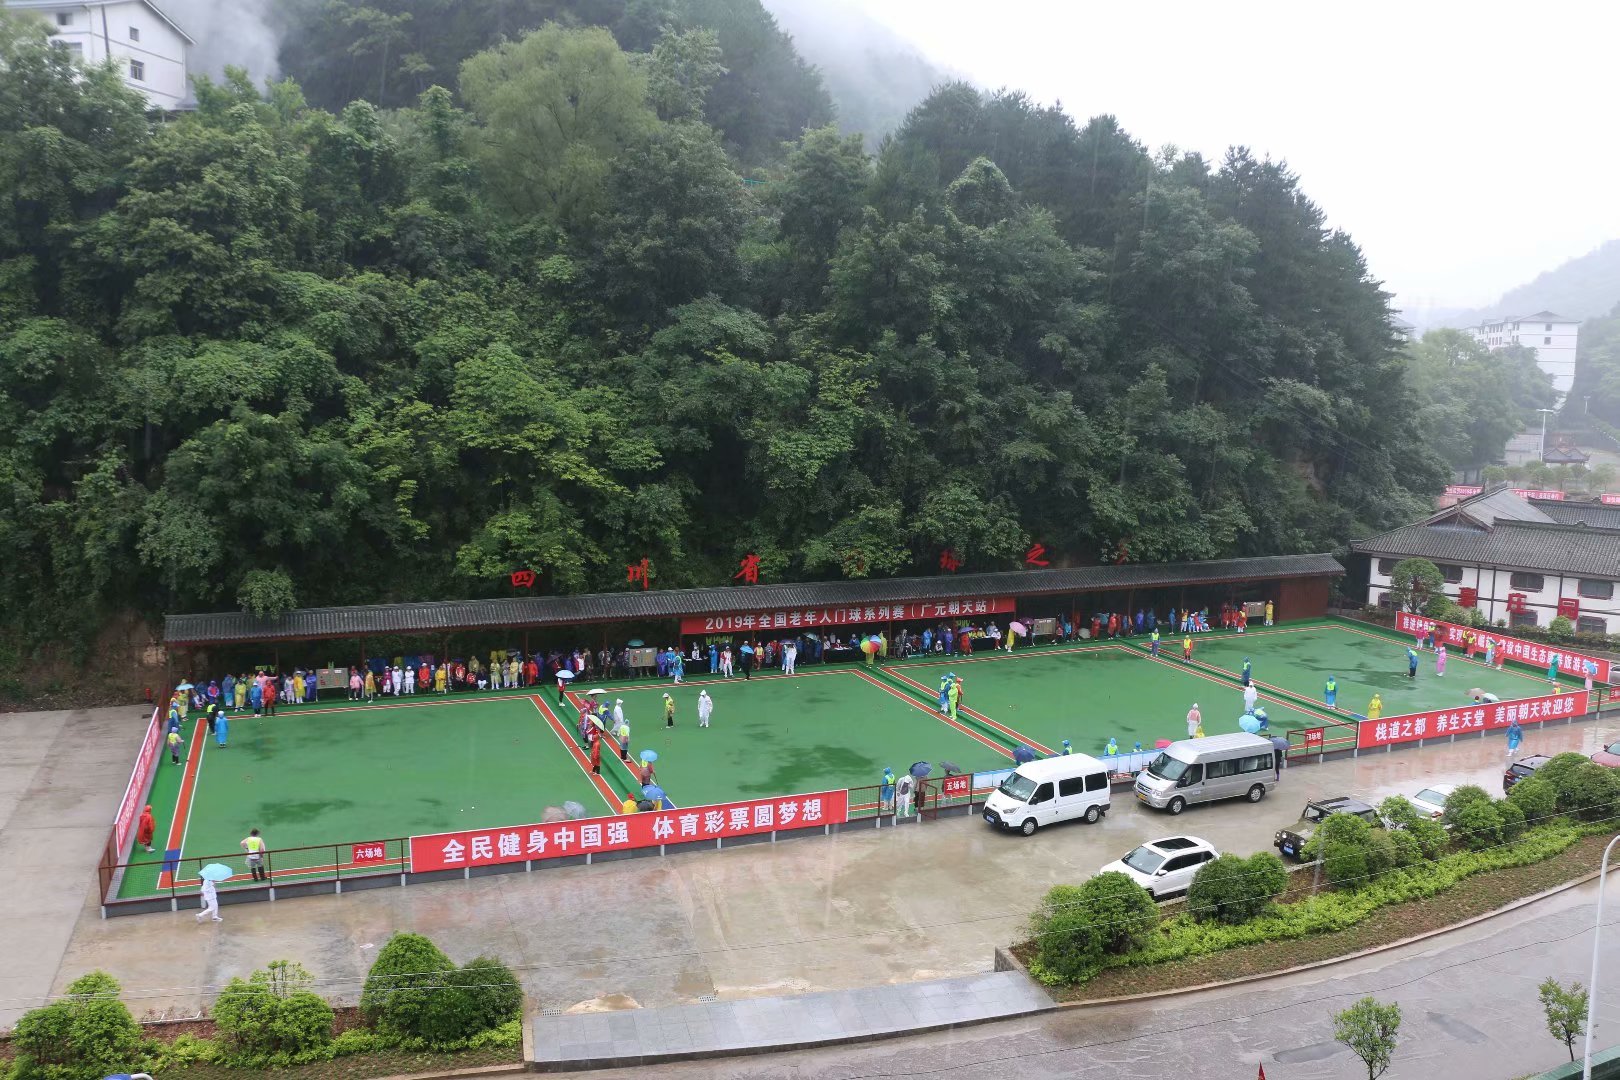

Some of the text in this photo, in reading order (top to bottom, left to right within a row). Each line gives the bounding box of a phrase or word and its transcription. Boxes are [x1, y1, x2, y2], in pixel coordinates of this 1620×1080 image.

[1374, 696, 1575, 742] 栈道之都 养生天堂 美丽朝天欢迎您
[946, 779, 967, 791] 五场地
[441, 798, 822, 864] 全民健身中国强 体育彩票圆梦想
[355, 846, 383, 859] 六场地
